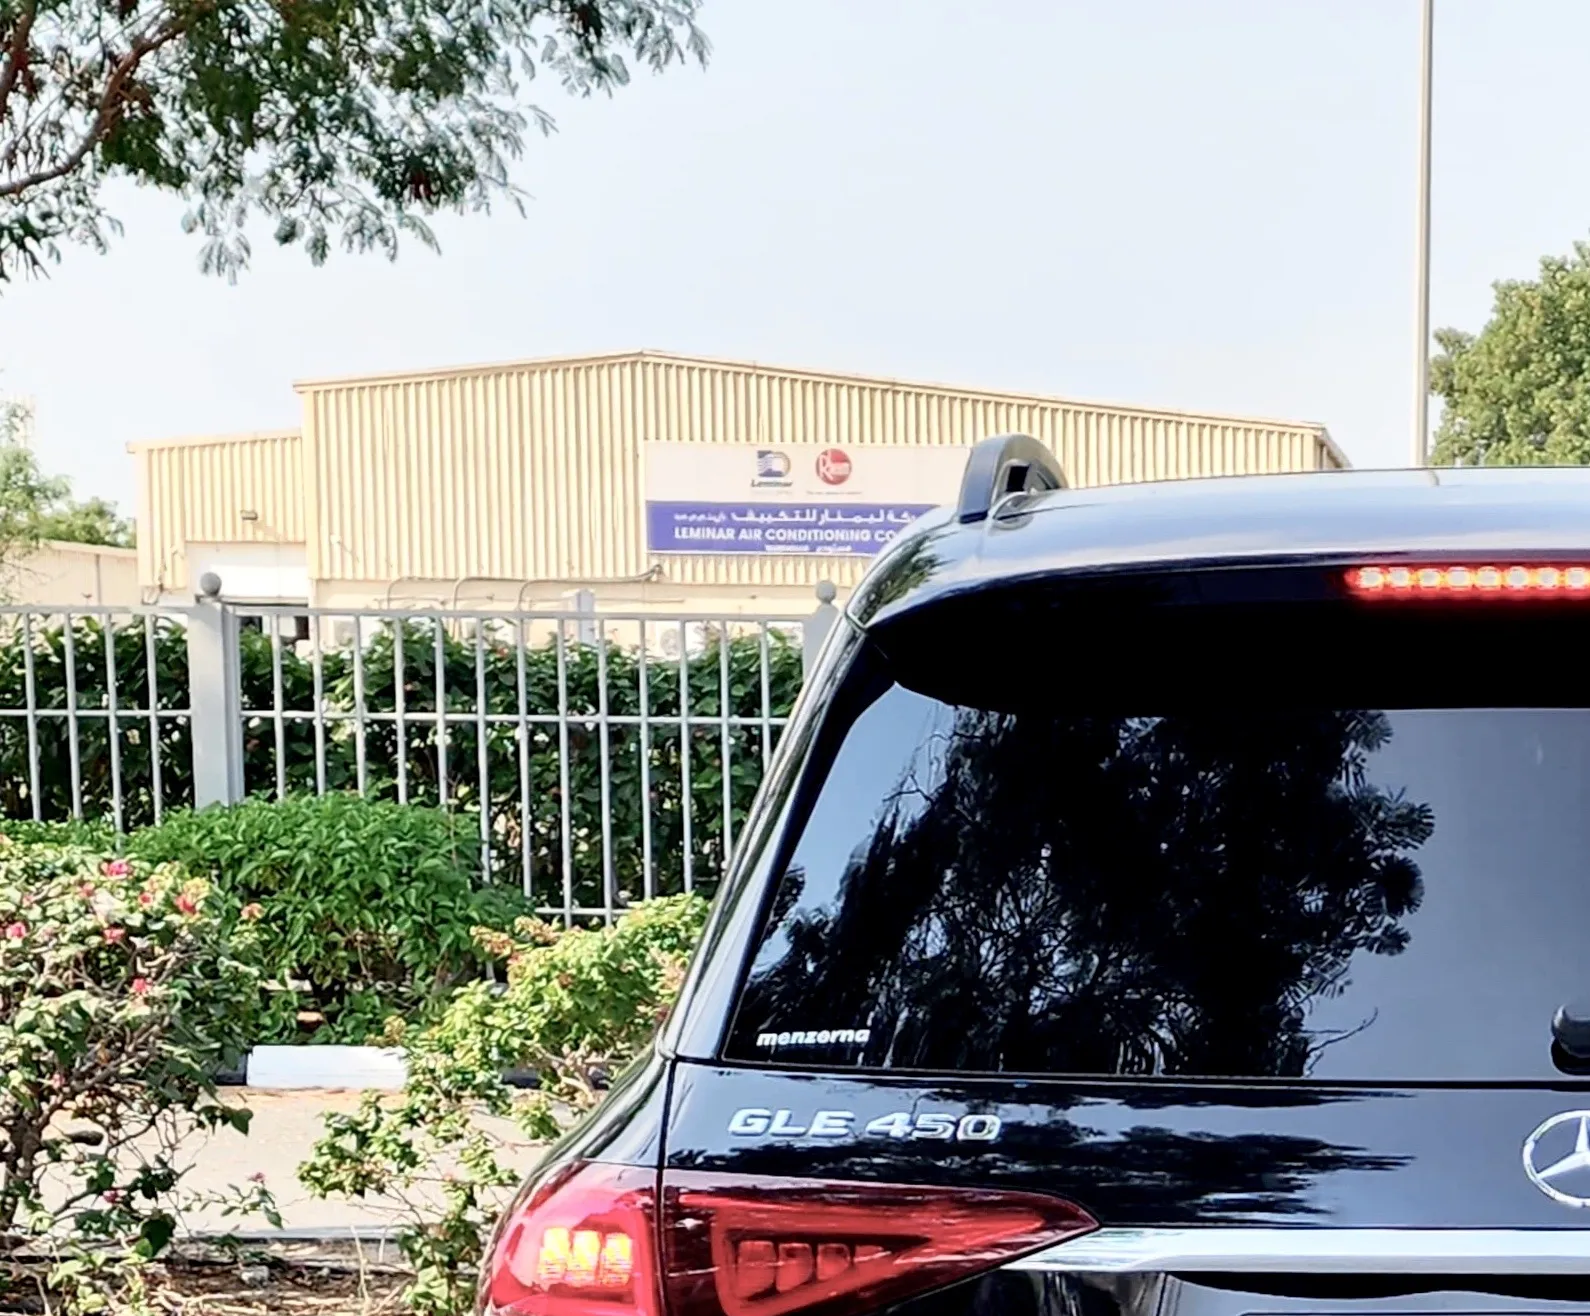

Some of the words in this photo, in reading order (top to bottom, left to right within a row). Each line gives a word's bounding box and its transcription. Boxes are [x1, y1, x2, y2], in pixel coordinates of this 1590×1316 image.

[674, 526, 736, 540] LEMINAR
[738, 528, 762, 541] AIR
[765, 529, 871, 542] CONDITIONING
[757, 1028, 870, 1046] menzerna
[728, 1108, 855, 1137] GLE
[864, 1112, 1001, 1141] 450
